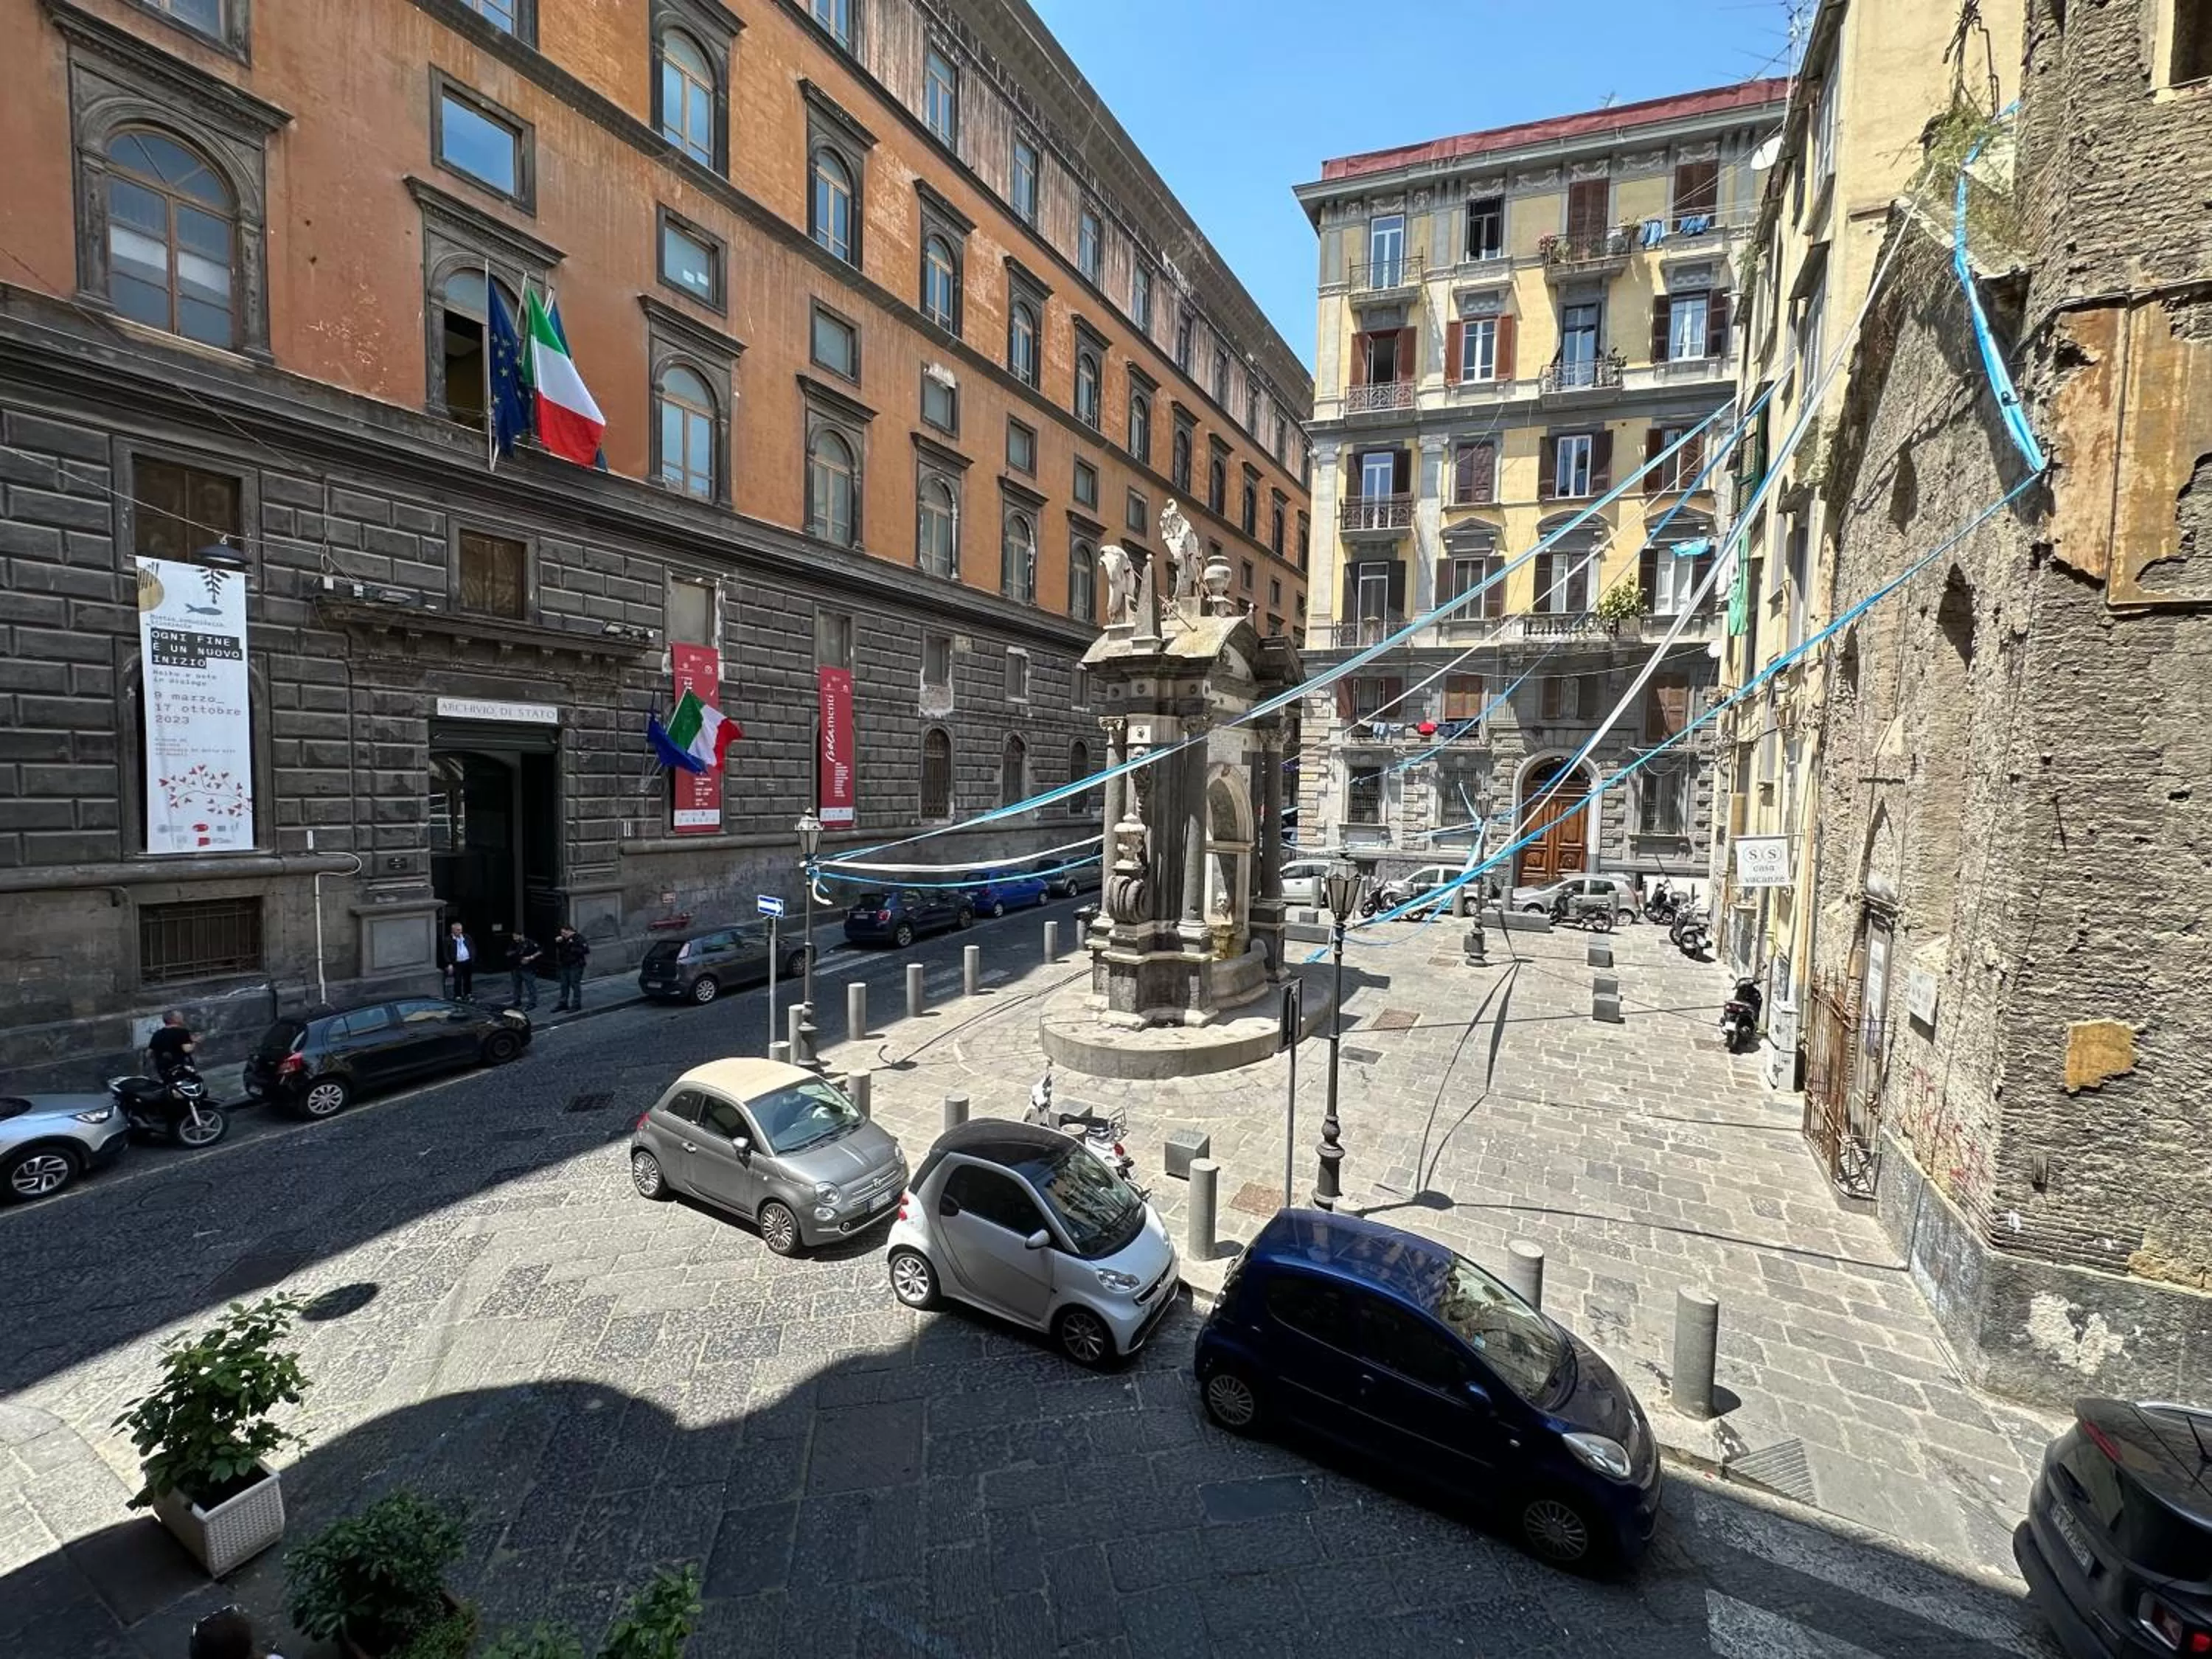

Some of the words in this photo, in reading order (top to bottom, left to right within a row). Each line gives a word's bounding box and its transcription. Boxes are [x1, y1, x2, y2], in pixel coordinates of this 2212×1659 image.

[151, 630, 187, 642] OGNI
[197, 635, 231, 647] FINE
[153, 640, 160, 651] È
[170, 644, 187, 653] UN
[197, 647, 240, 658] NUOVO
[153, 655, 206, 667] INIZIO
[155, 702, 171, 712] 17
[181, 704, 242, 716] ottobre
[442, 703, 495, 714] ARCHIVIO
[500, 707, 512, 716] DI
[518, 709, 556, 719] STATO
[155, 714, 190, 725] 2023
